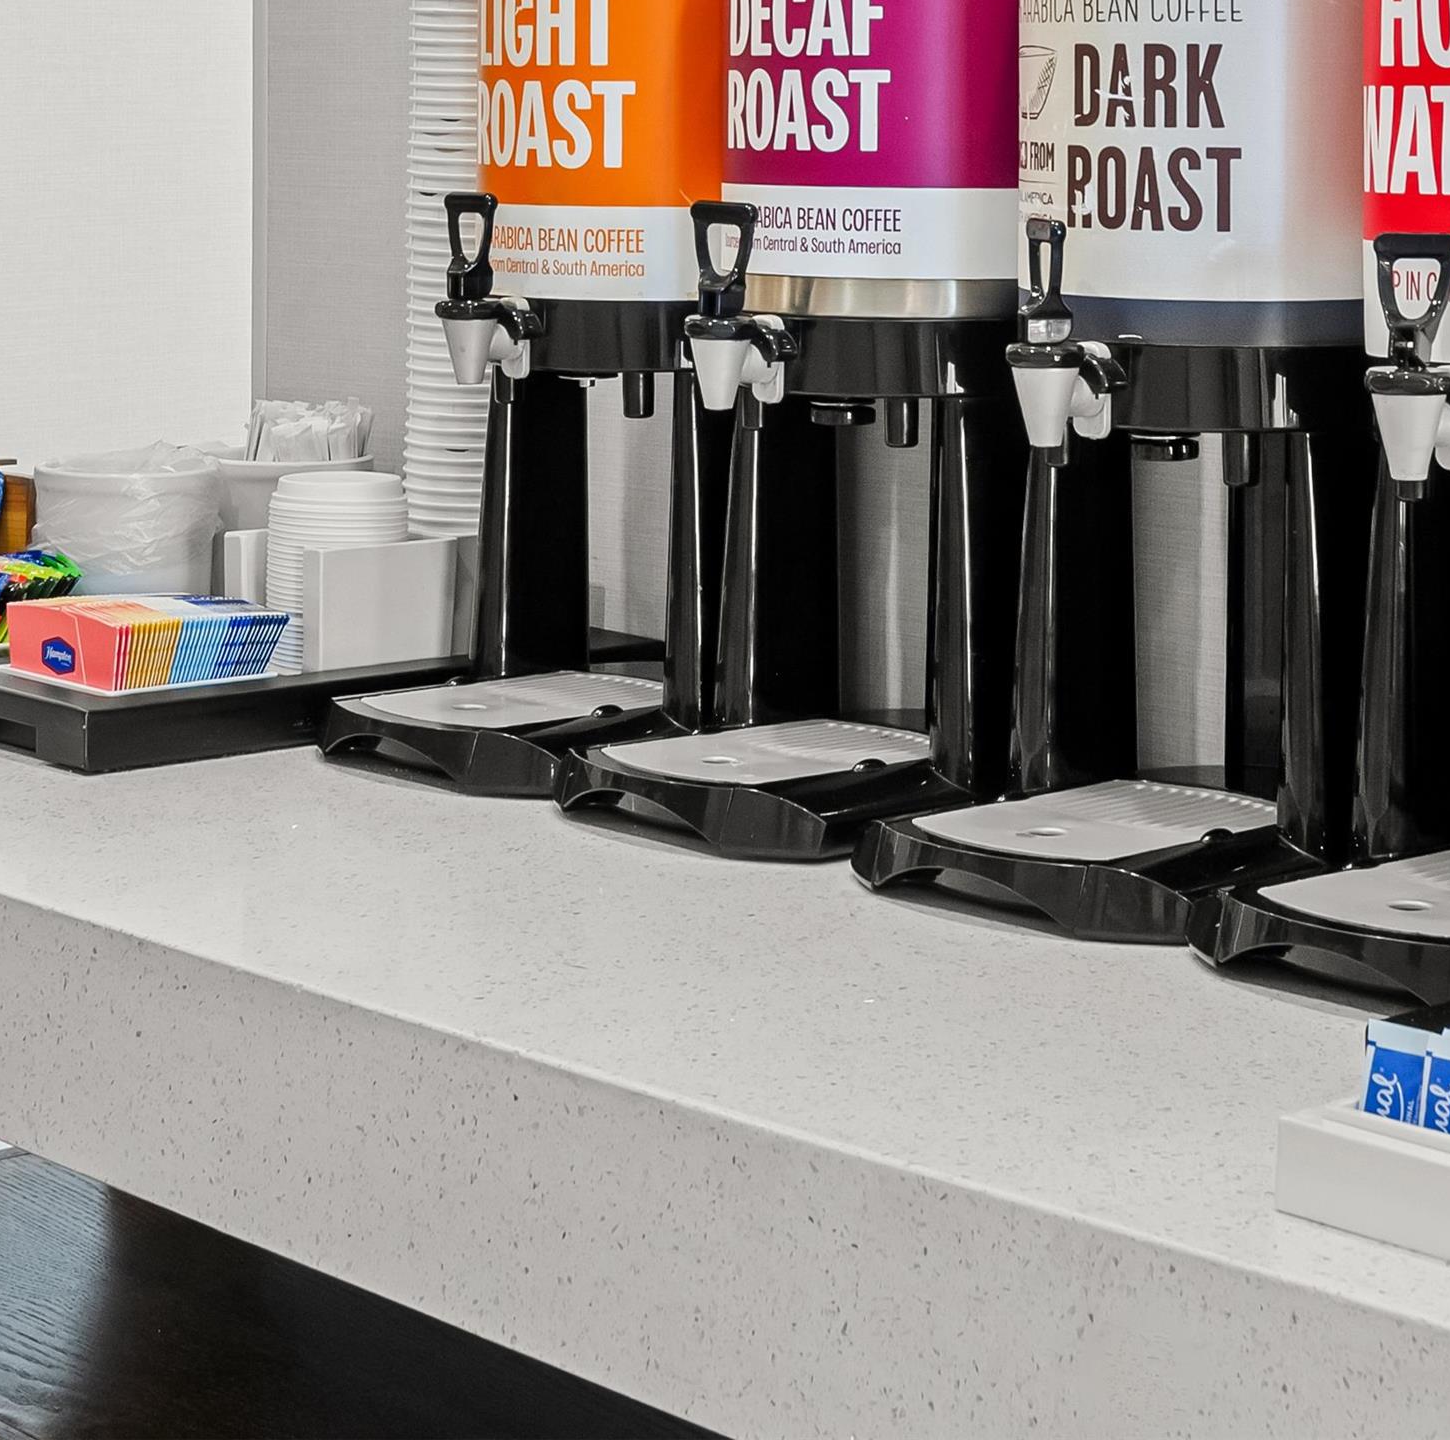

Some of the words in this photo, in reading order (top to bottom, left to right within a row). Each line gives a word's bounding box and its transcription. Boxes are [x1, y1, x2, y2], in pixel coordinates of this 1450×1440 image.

[1074, 42, 1226, 129] DARK
[477, 79, 636, 169] ROAST
[728, 68, 891, 154] ROAST
[1067, 147, 1242, 233] ROAST
[755, 206, 792, 229] ABICA
[797, 207, 836, 230] BEAN
[842, 208, 901, 232] COFFEE
[493, 225, 533, 252] RABICA
[538, 228, 578, 252] BEAN
[584, 228, 644, 253] COFFEE
[763, 236, 797, 252] Central
[801, 237, 808, 252] &
[811, 237, 844, 254] South
[848, 239, 901, 255] America
[506, 258, 538, 274] Central
[542, 260, 550, 275] &
[552, 260, 587, 276] South
[590, 260, 644, 277] America
[1406, 271, 1420, 301] IN
